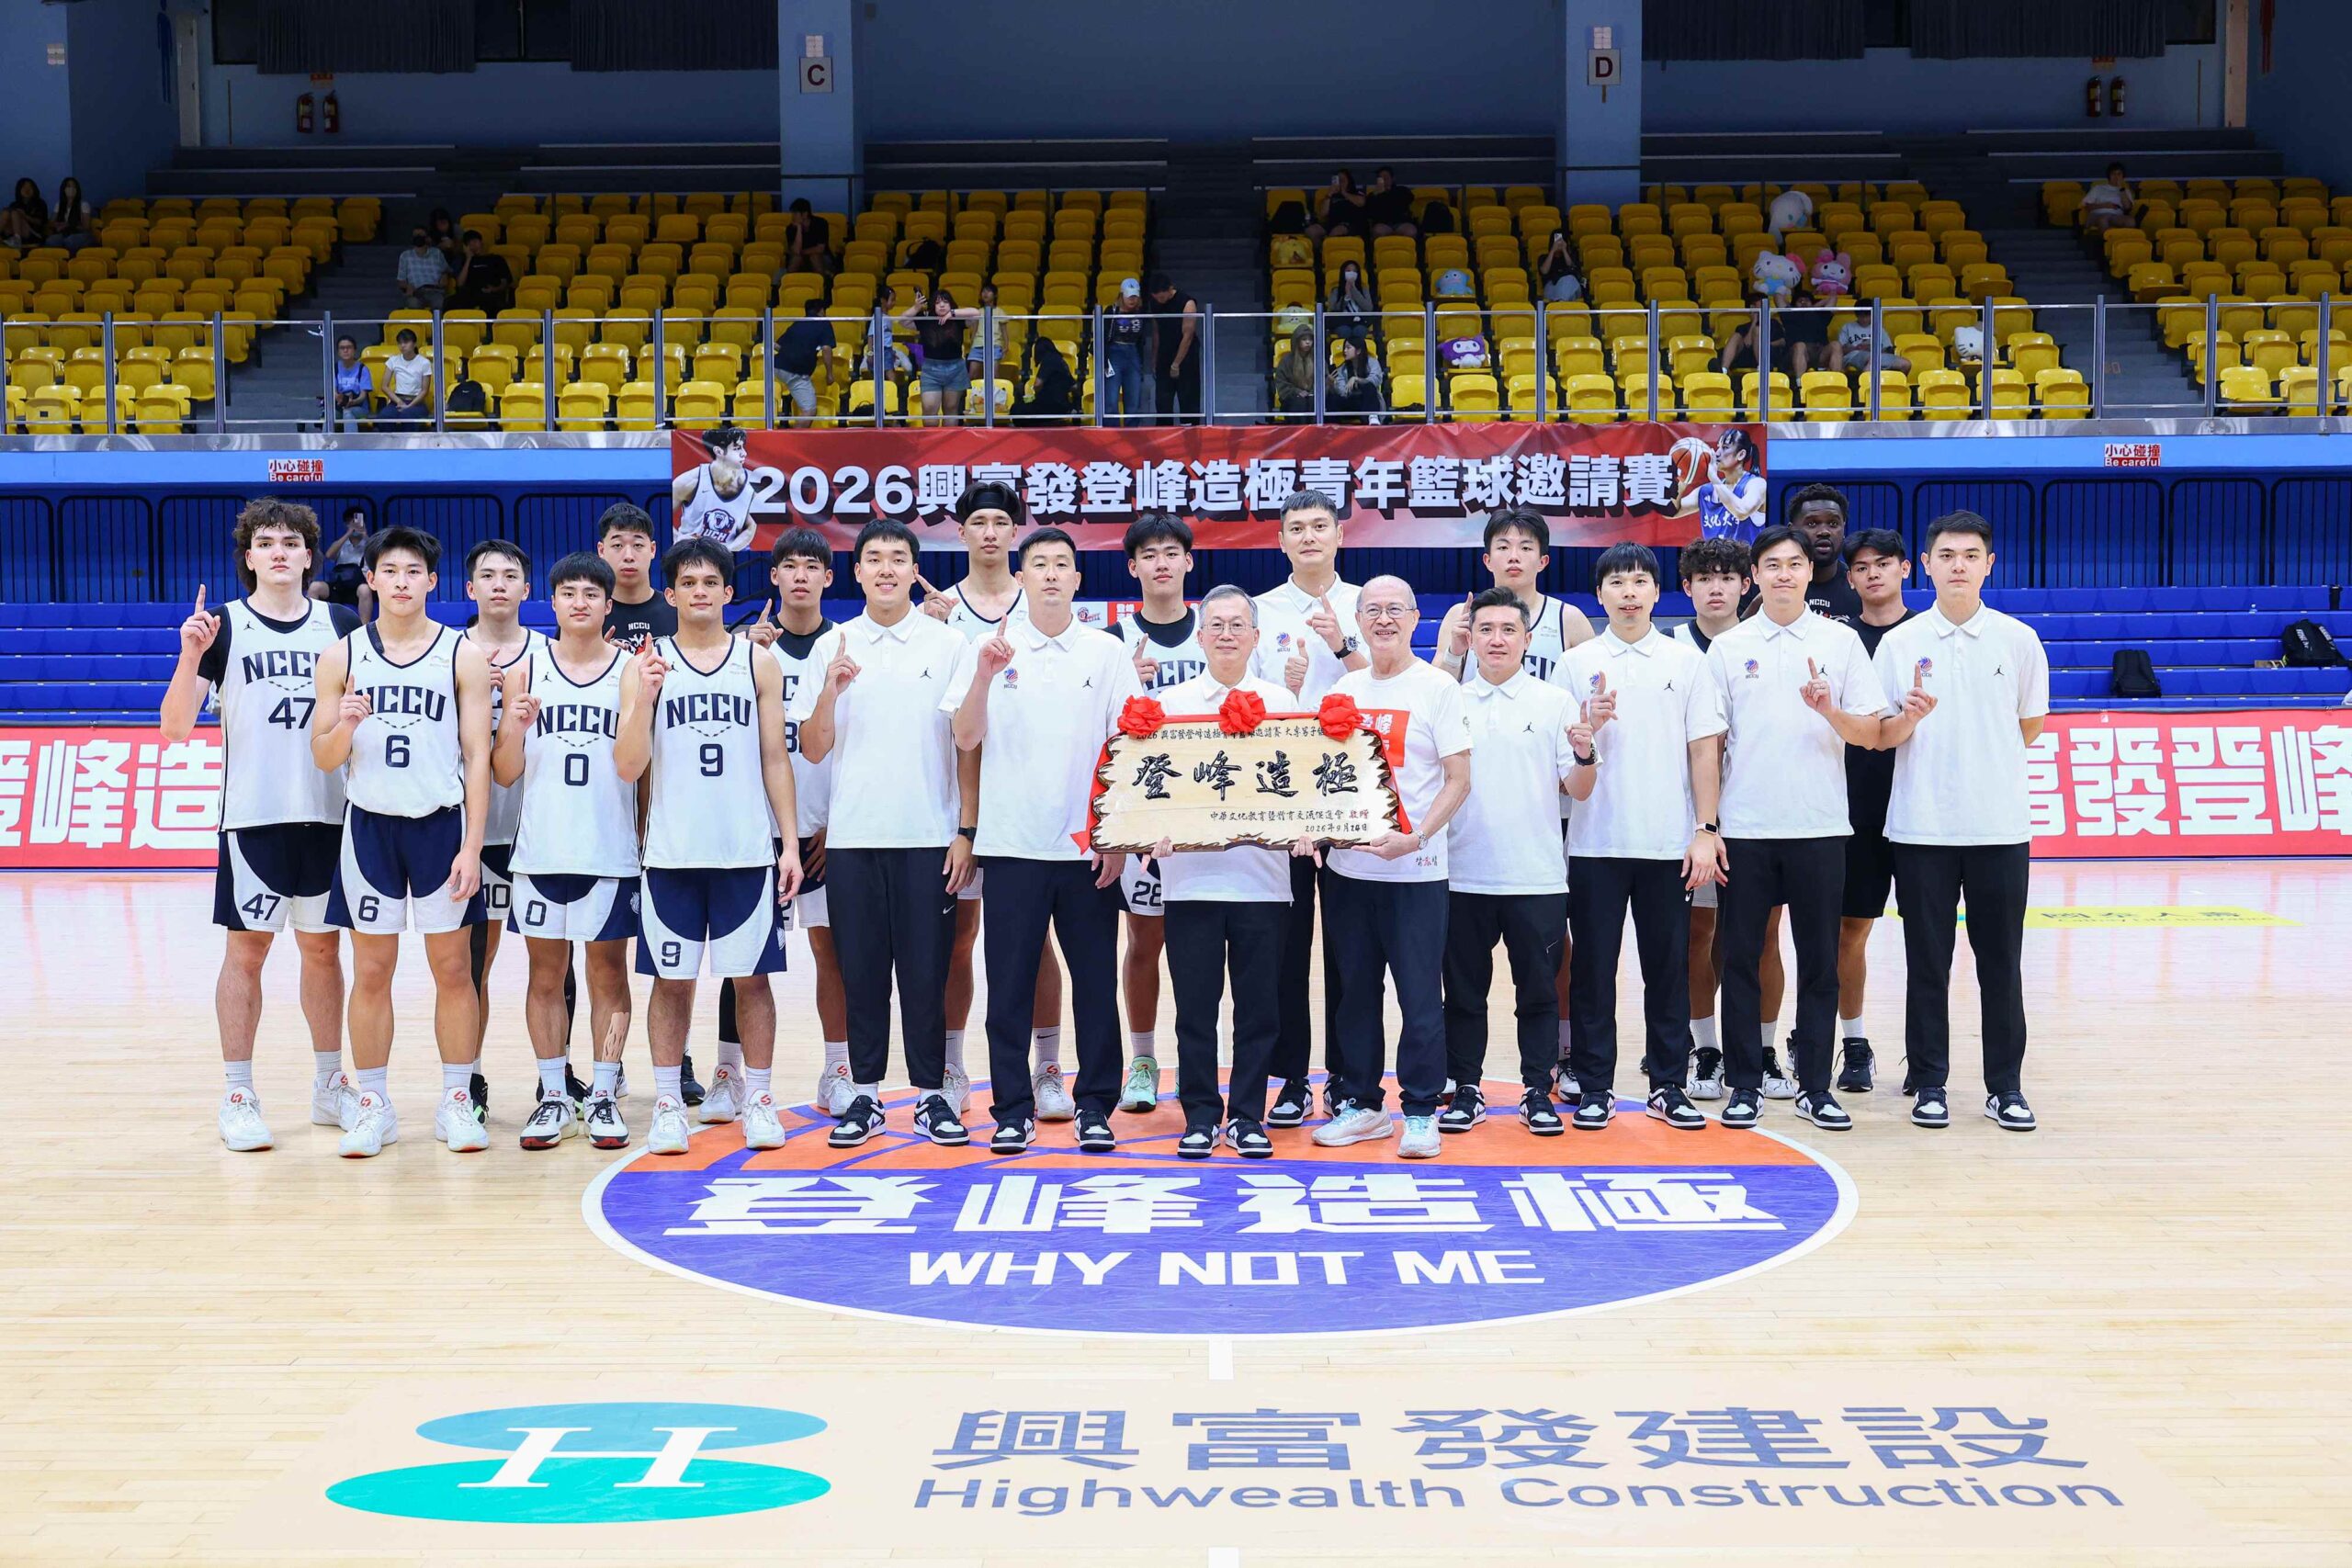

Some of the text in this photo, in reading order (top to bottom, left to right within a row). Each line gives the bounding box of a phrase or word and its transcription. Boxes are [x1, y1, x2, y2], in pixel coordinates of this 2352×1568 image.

[808, 64, 825, 85] C
[1595, 57, 1613, 77] D
[2105, 444, 2160, 457] 小心碰撞
[2105, 457, 2161, 467] Be careful
[269, 459, 323, 472] 小心碰撞
[270, 473, 324, 482] Be careful
[1808, 598, 1831, 608] NCCU
[628, 622, 650, 630] NCCU
[1145, 660, 1206, 691] CC
[268, 697, 317, 729] 47
[537, 705, 620, 740] NCCU
[666, 694, 752, 728] NCCU
[386, 735, 410, 768] 6
[700, 743, 723, 777] 9
[564, 753, 589, 786] 0
[1132, 750, 1359, 801] 登峰造極
[242, 893, 281, 921] 47
[358, 896, 380, 922] 6
[482, 884, 511, 908] 10
[525, 900, 548, 927] 0
[662, 942, 682, 967] 9
[662, 1172, 1787, 1235] 登峰造極
[910, 1250, 1545, 1286] WHY NOT ME
[932, 1407, 2089, 1471] 興富發建設
[458, 1427, 738, 1488] H
[914, 1476, 2124, 1517] Highwealth Construction
